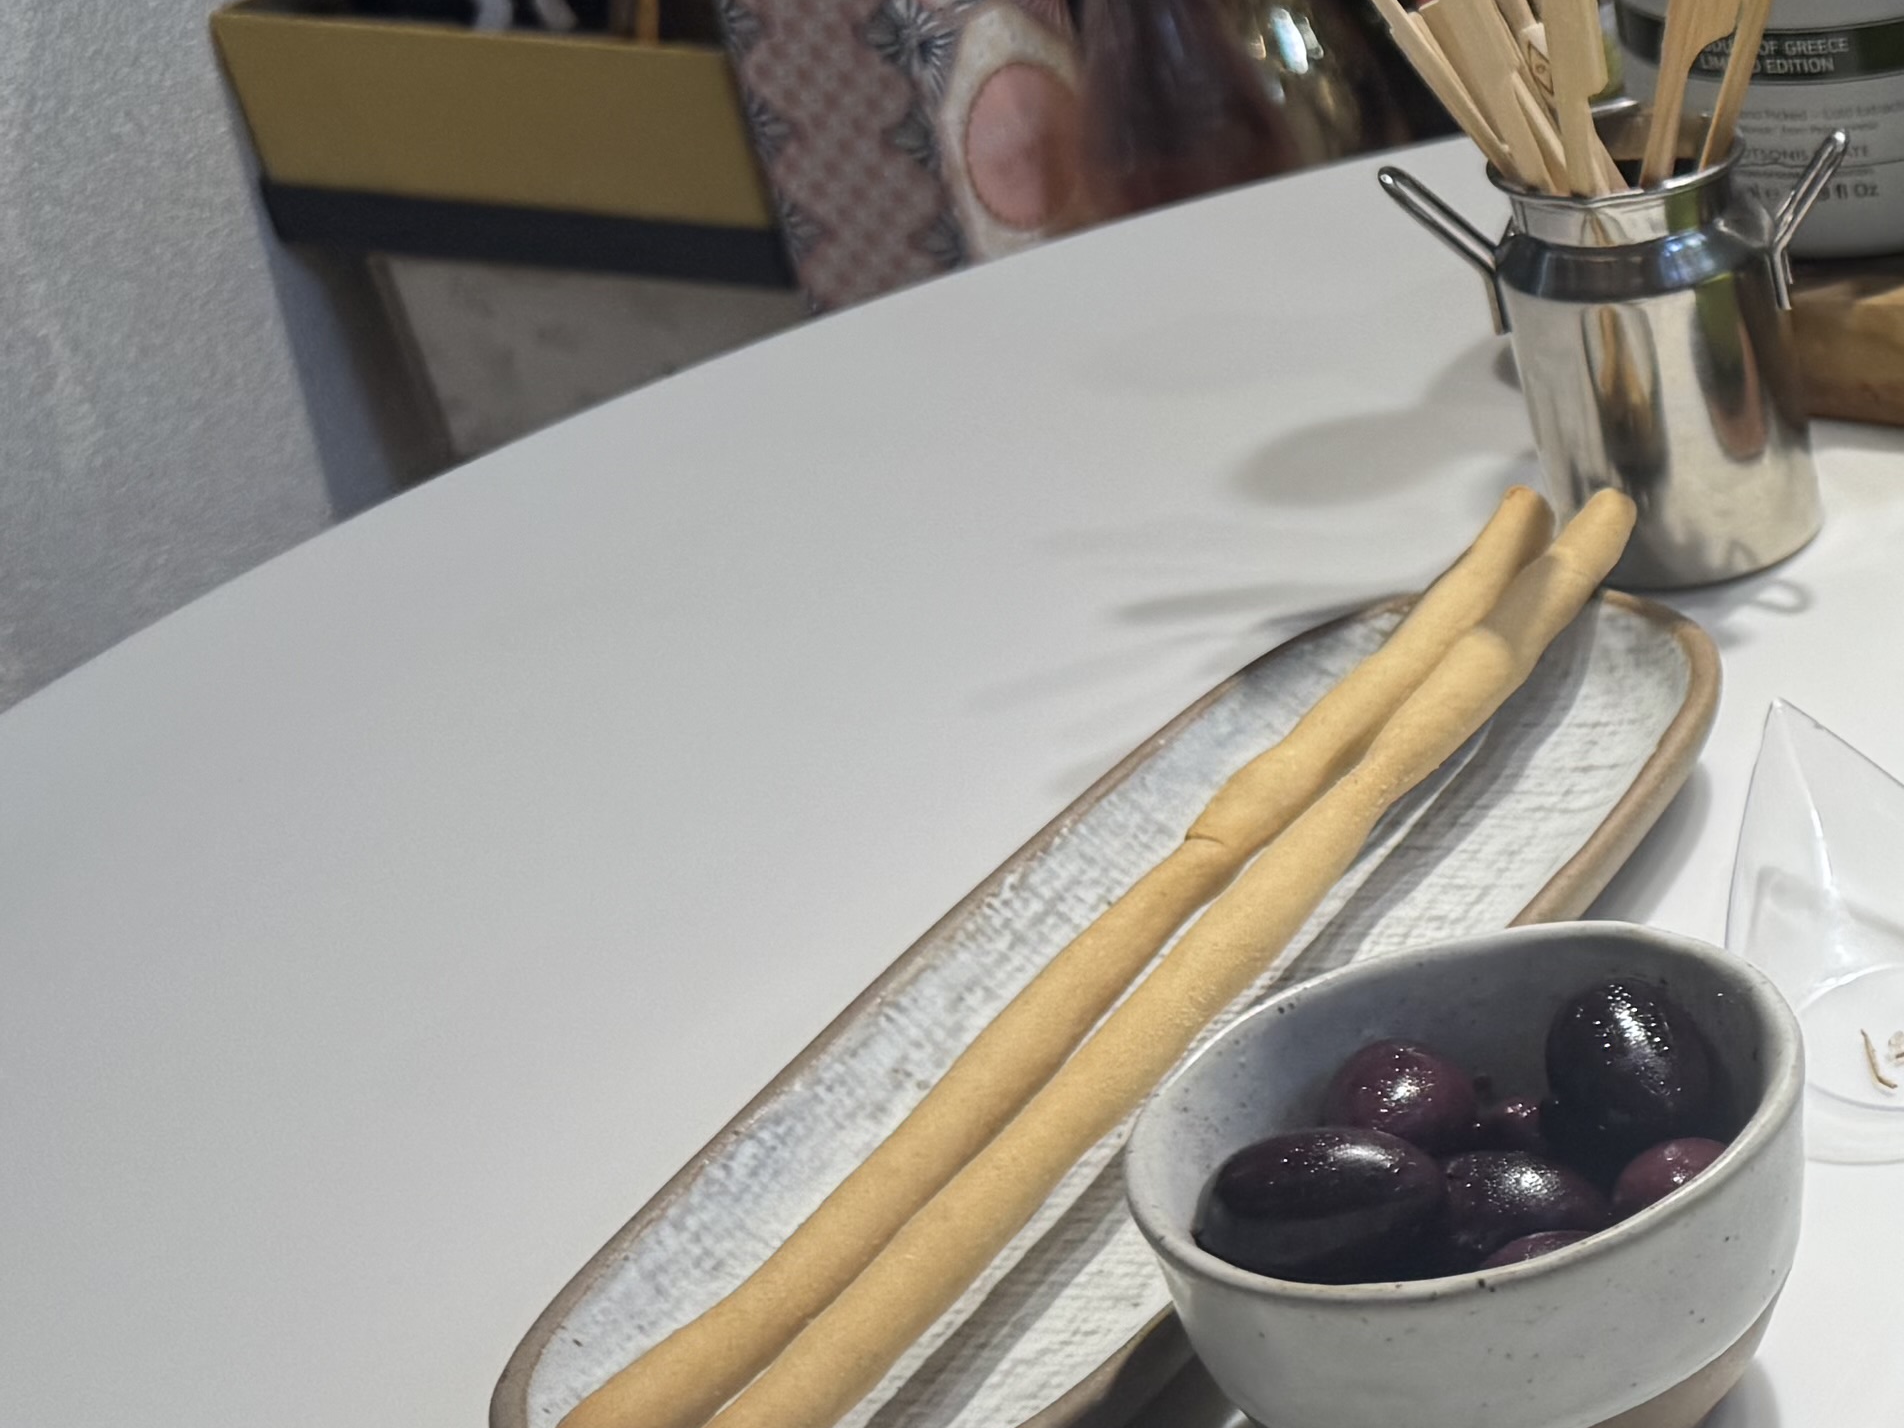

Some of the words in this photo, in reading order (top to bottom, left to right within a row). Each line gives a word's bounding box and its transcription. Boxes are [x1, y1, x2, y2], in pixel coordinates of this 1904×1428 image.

[1785, 37, 1849, 55] GREECE
[1765, 57, 1835, 74] EDITION
[1853, 182, 1880, 198] Oz
